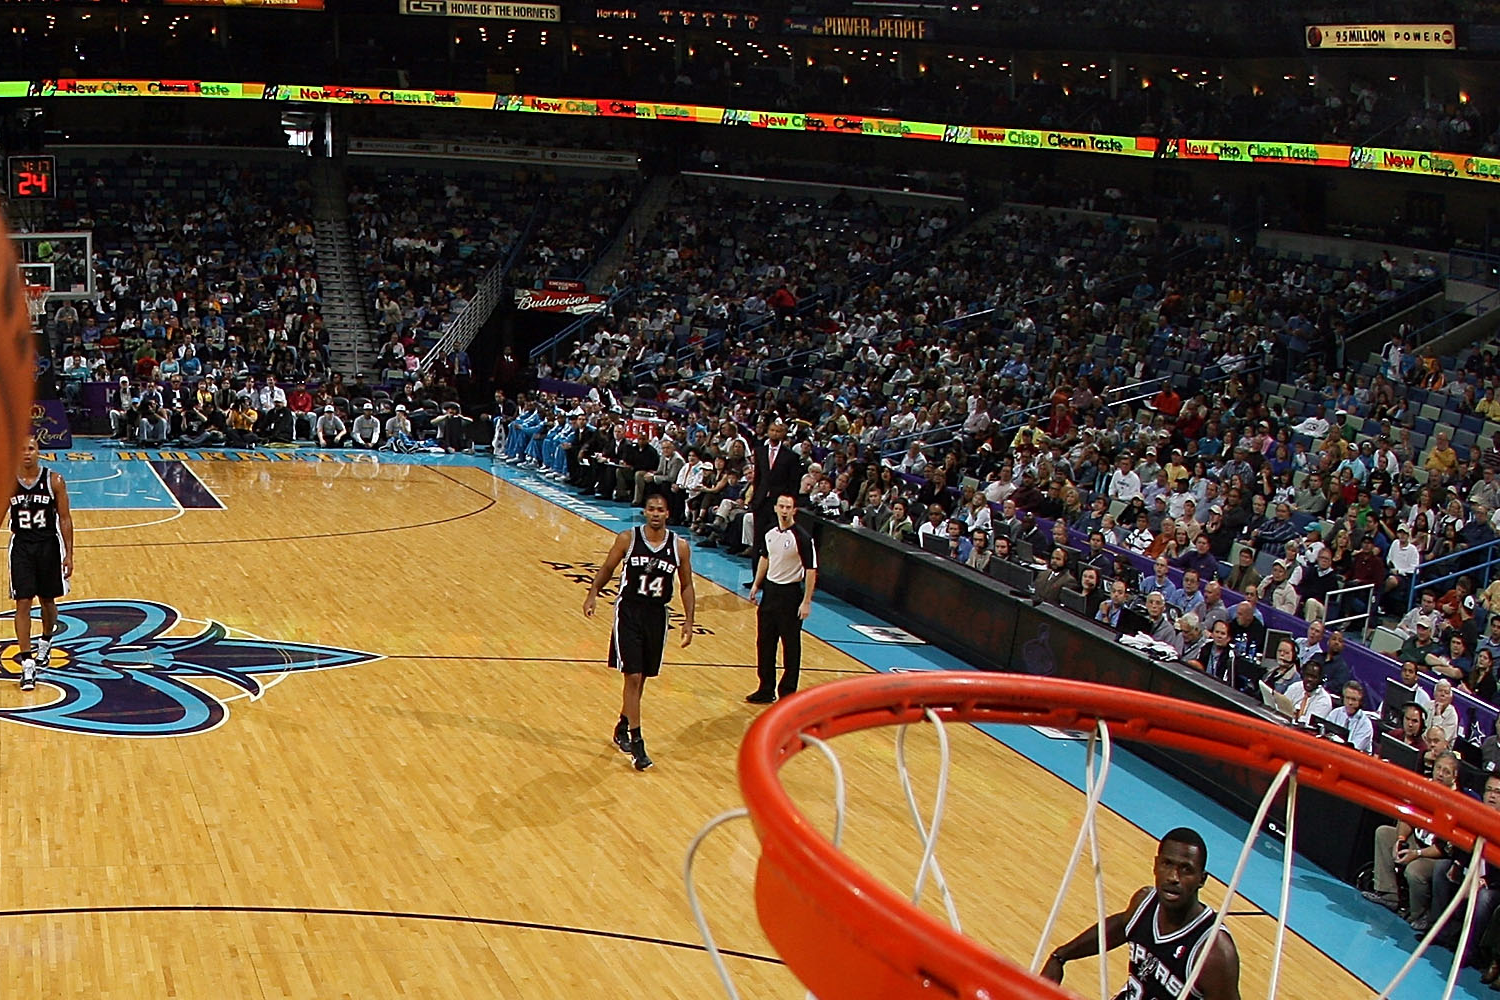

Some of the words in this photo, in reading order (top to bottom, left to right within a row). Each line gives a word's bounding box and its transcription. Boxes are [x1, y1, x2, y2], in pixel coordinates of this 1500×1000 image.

[451, 3, 478, 15] HOME
[480, 4, 492, 15] OF
[495, 4, 512, 17] THE
[513, 6, 556, 19] HORNETS
[596, 9, 637, 20] Hornets
[824, 16, 871, 37] POWER
[879, 18, 926, 40] PEOPLE
[1348, 30, 1385, 42] MILLION
[1395, 31, 1441, 42] POWER
[66, 82, 98, 94] New
[300, 88, 332, 99] New
[532, 99, 562, 112] New
[759, 114, 787, 127] New
[978, 130, 1006, 143] New
[1008, 131, 1043, 147] Crisp,
[1048, 134, 1087, 149] Clean
[1089, 136, 1123, 152] Taste
[1384, 151, 1415, 168] New
[18, 172, 49, 196] 24
[517, 294, 590, 311] Budweiser
[33, 427, 68, 446] Royal
[11, 494, 51, 506] SPURS
[18, 510, 47, 529] 24
[630, 556, 676, 574] SPURS
[637, 575, 664, 598] 14
[1128, 940, 1184, 998] SPURS
